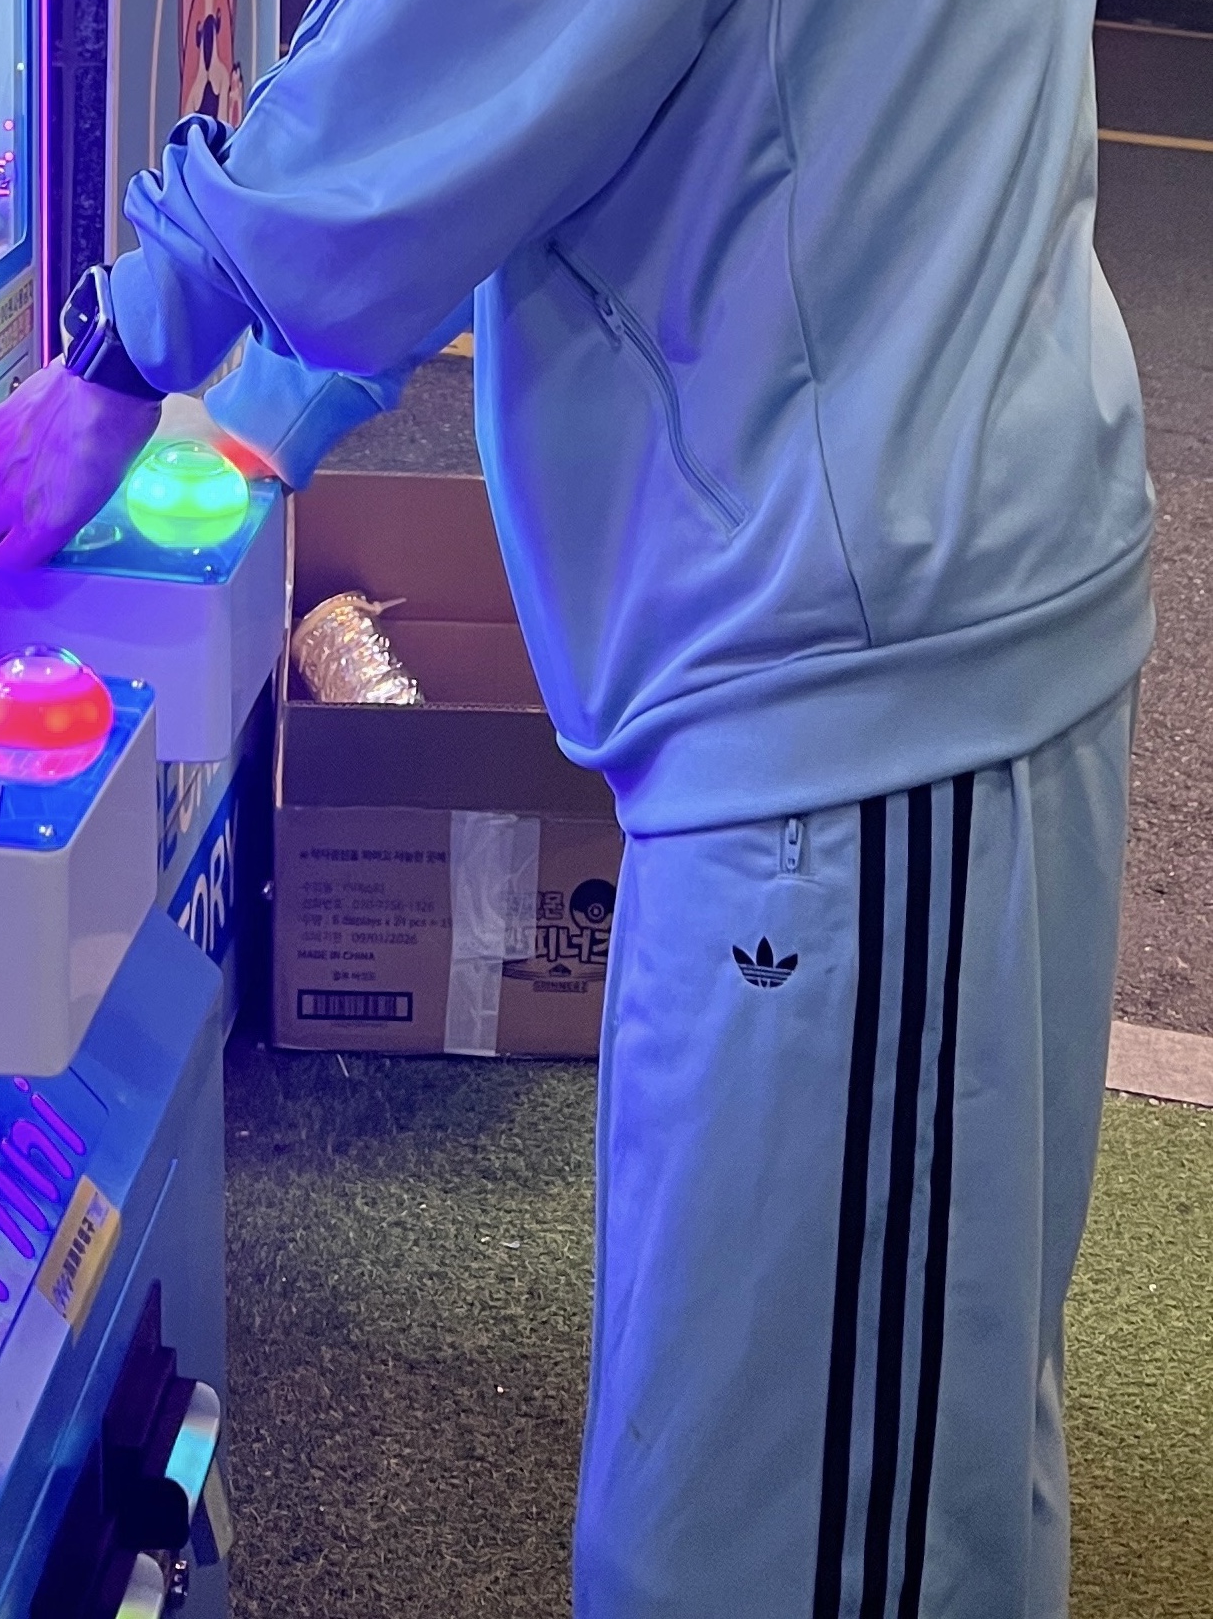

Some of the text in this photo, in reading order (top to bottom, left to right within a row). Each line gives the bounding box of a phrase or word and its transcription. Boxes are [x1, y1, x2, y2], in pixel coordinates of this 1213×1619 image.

[178, 797, 239, 953] ORY
[297, 949, 327, 961] MADE
[343, 950, 376, 961] CHINA
